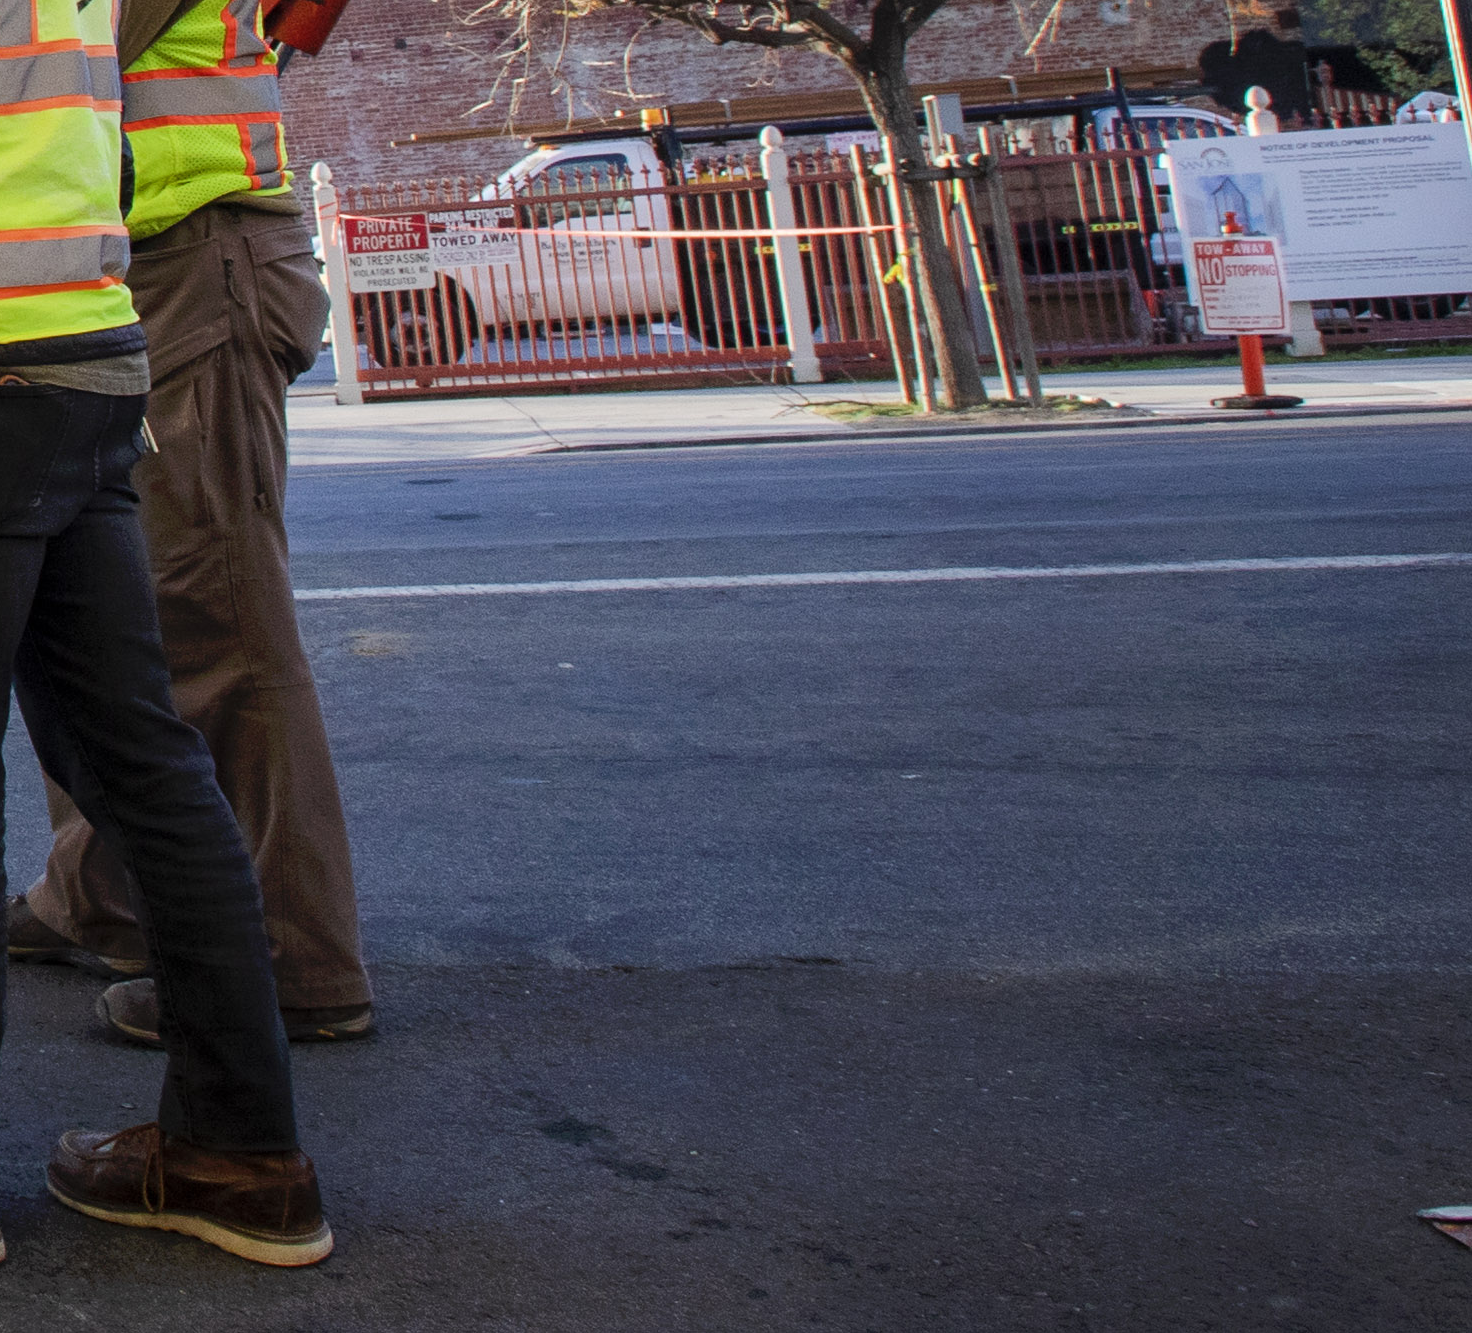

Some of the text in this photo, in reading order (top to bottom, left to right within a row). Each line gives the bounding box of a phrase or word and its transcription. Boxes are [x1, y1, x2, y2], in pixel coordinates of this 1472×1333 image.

[1260, 134, 1435, 152] NOTICE OF DEVELOPMENT PROPOSAL
[357, 216, 414, 234] PRIVATE
[352, 232, 421, 251] PROPERTY
[432, 232, 516, 247] TOWED AWAY
[349, 256, 362, 267] NO
[366, 252, 430, 266] TRESPASSING
[353, 267, 396, 278] VIOLATORS
[398, 266, 416, 275] WILL
[1198, 256, 1224, 285] NO
[1226, 263, 1277, 277] STOPPING
[367, 276, 417, 287] PROSECUTED
